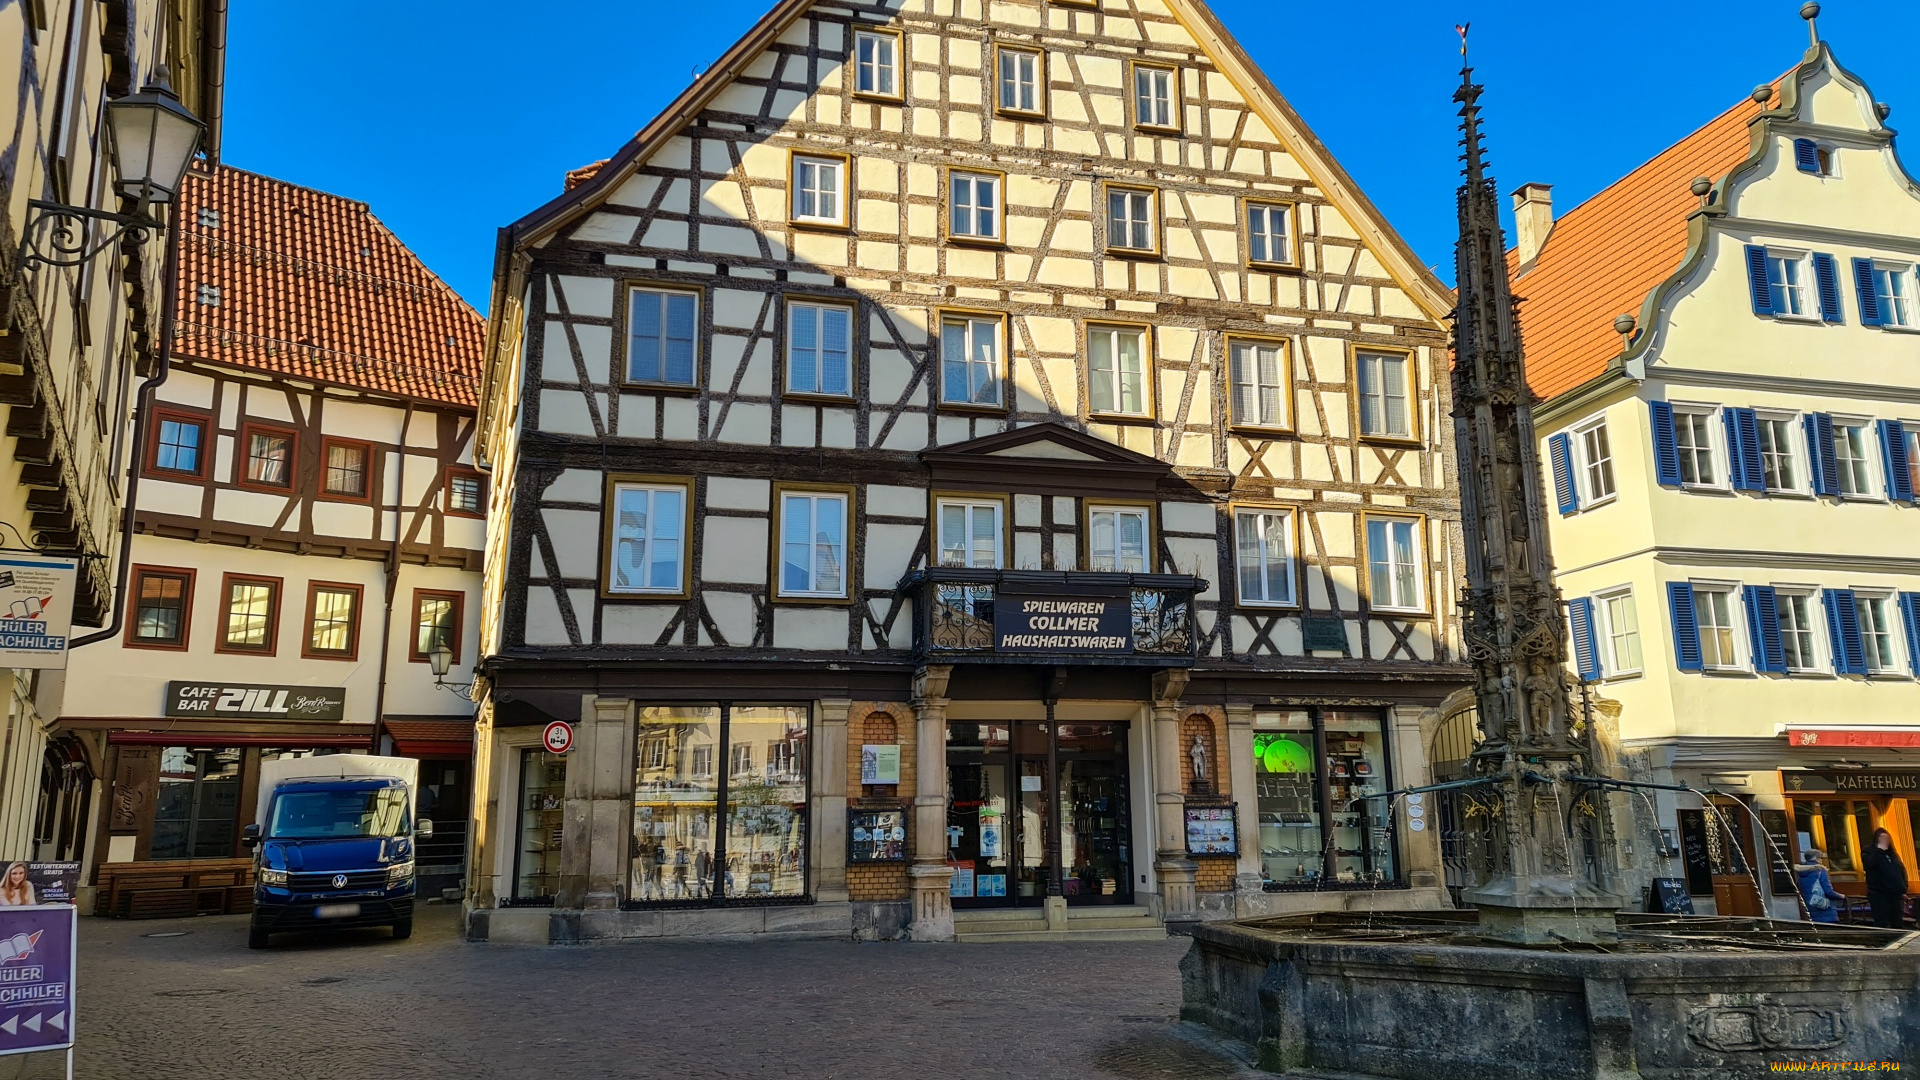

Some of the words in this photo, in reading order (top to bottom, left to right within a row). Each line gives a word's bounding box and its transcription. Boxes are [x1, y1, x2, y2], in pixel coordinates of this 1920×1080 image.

[1022, 600, 1105, 615] SPIELWAREN
[1029, 616, 1099, 632] COLLMER
[1002, 634, 1127, 650] HAUSHALTSWAREN
[179, 686, 218, 698] CAFE
[177, 699, 210, 711] BAR
[1836, 775, 1918, 789] KAFFEEHAUS
